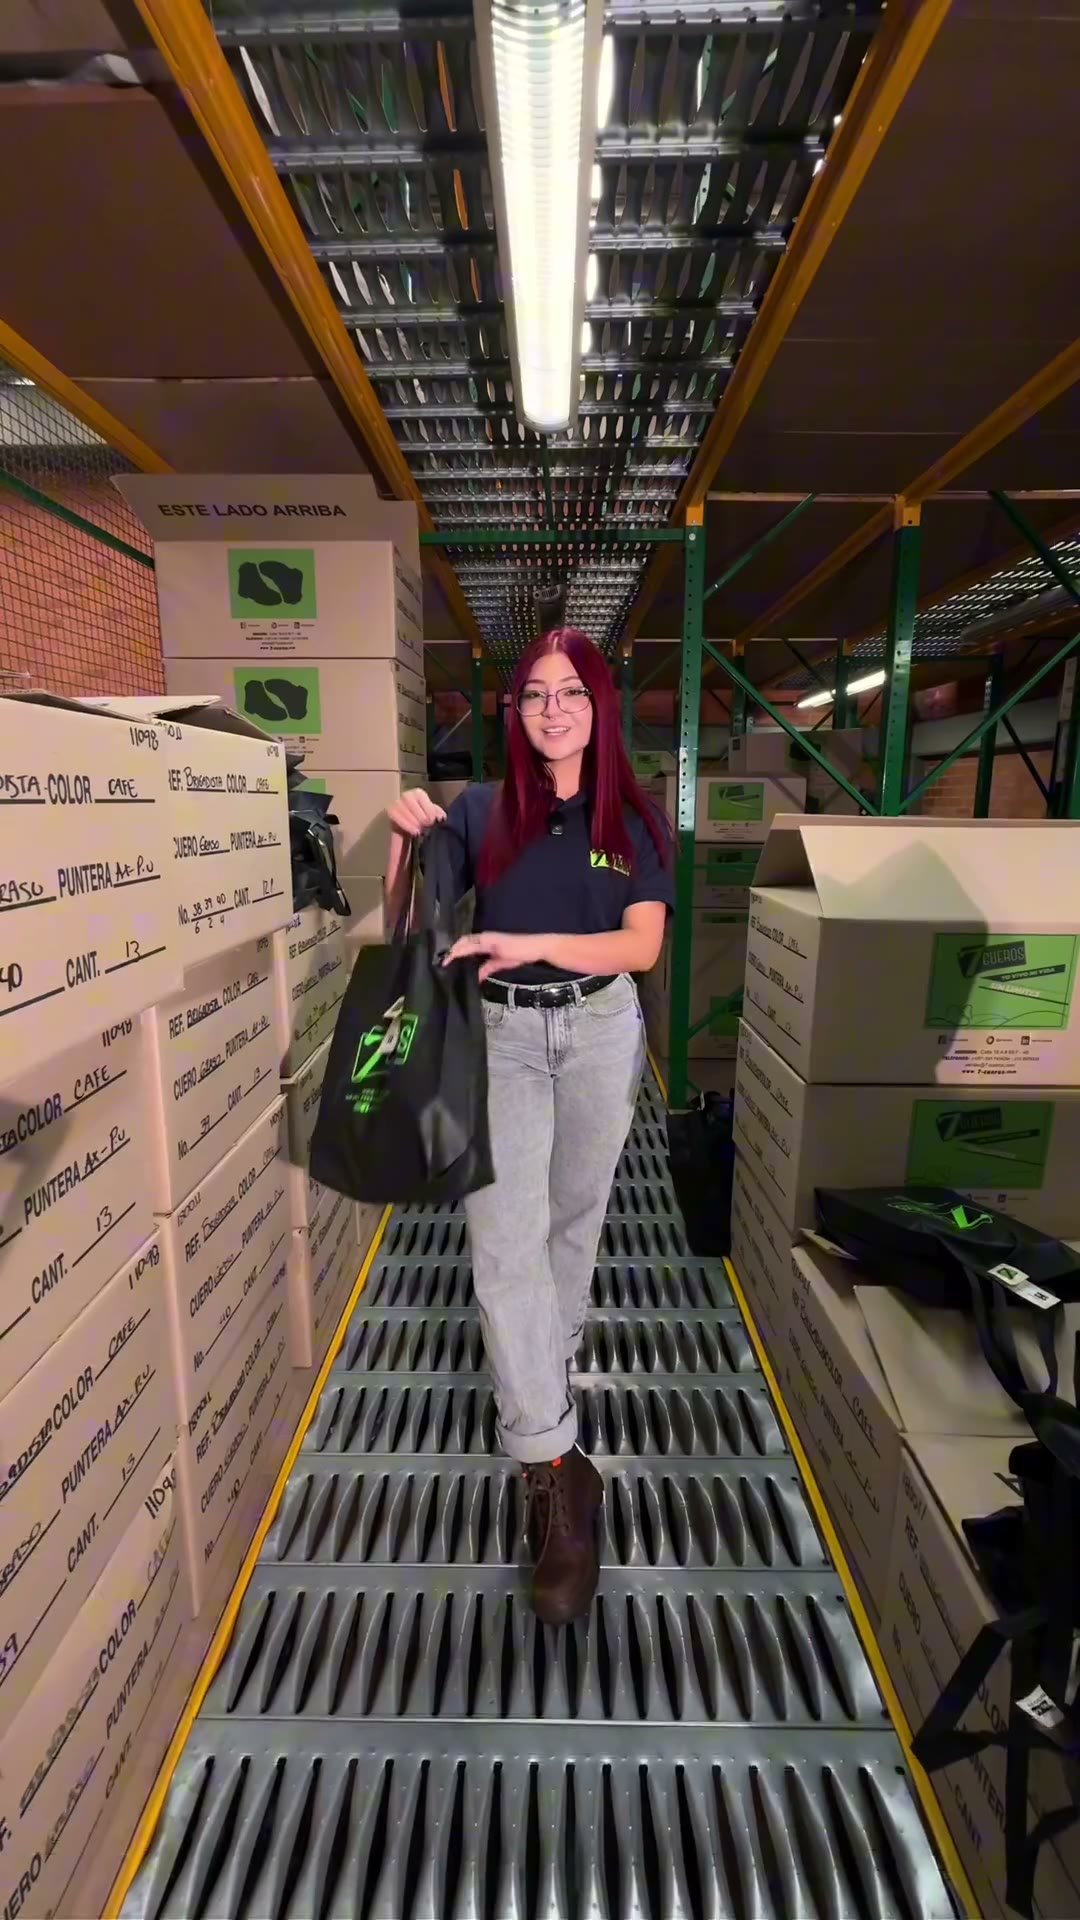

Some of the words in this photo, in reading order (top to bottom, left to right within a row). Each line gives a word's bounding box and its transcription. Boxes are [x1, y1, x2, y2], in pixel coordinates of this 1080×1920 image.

[158, 503, 210, 518] ESTE
[213, 503, 268, 517] LADO
[272, 503, 347, 518] ARRIBA
[129, 726, 159, 751] 11098
[47, 773, 93, 805] COLOR
[108, 777, 138, 799] CAFE
[226, 773, 247, 794] COLOR
[230, 830, 257, 852] PUNTERA
[57, 861, 113, 898] PUNTERA
[66, 950, 101, 989] CANT.
[125, 940, 141, 963] 13
[982, 945, 1025, 967] CUEROS
[168, 1012, 185, 1040] REF.
[222, 980, 241, 1006] COLOR
[173, 1066, 198, 1101] CUERO
[225, 1028, 248, 1059] PUNTERA
[17, 1092, 63, 1141] COLOR
[73, 1064, 111, 1101] CAFE
[24, 1160, 82, 1226] PUNTERA
[184, 1232, 202, 1264] REF.
[238, 1167, 257, 1200] COLOR
[31, 1252, 69, 1304] CANT.
[96, 1205, 113, 1233] 13
[189, 1274, 214, 1319] CUERO
[52, 1365, 94, 1432] COLOR
[61, 1419, 113, 1504] PUNTERA
[195, 1429, 213, 1465] REF.
[200, 1463, 223, 1514] CUERO
[67, 1511, 100, 1573] CANT.
[98, 1599, 137, 1675] COLOR
[105, 1639, 151, 1741] PUNTERA
[105, 1730, 133, 1800] CANT.
